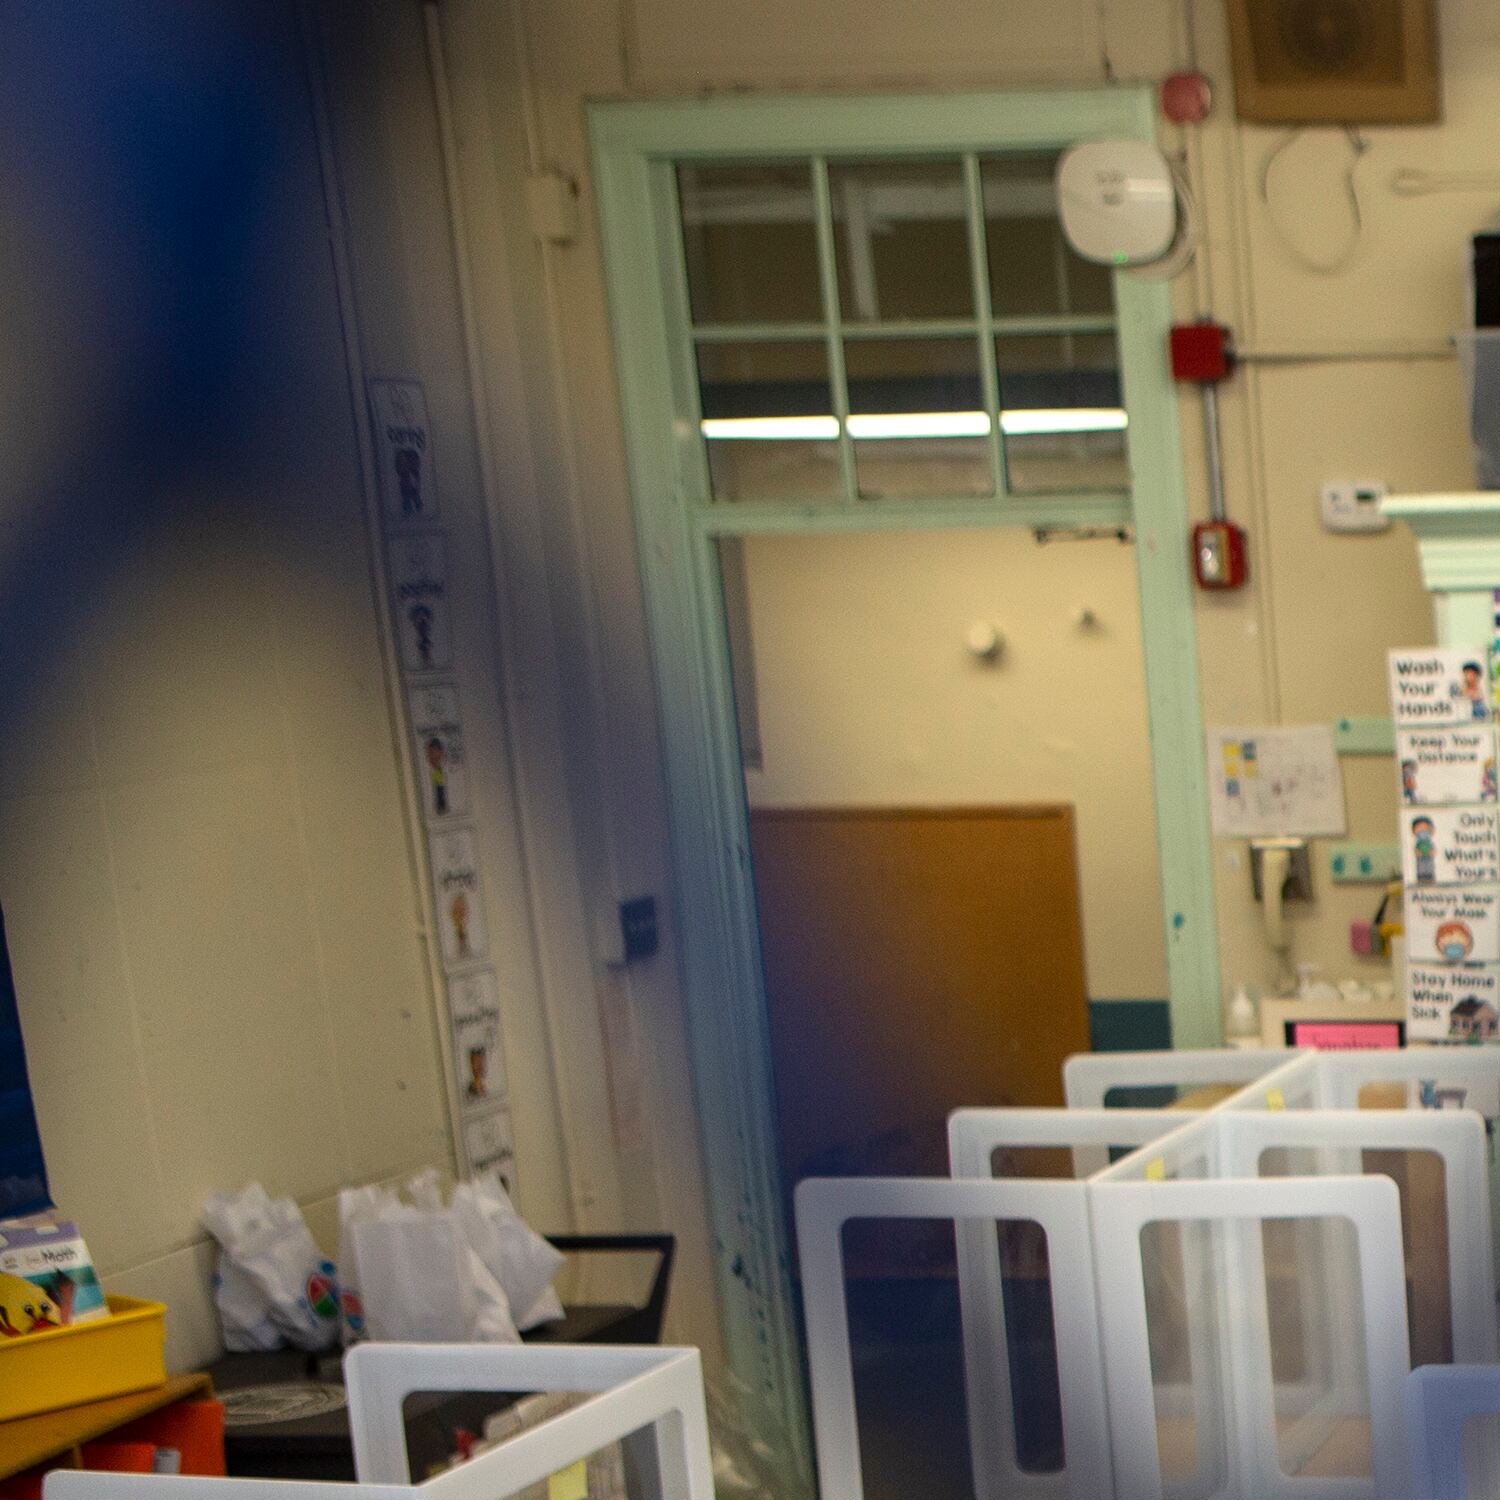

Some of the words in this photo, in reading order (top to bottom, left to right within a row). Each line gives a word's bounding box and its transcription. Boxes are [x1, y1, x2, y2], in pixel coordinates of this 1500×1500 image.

[1396, 659, 1444, 677] Wash
[1398, 681, 1436, 696] Your
[1399, 700, 1453, 717] Hands
[1410, 736, 1446, 751] Keep
[1452, 734, 1482, 747] Your
[1418, 750, 1478, 764] Distance
[1460, 814, 1496, 831] Only
[1454, 831, 1497, 845] Touch
[1444, 847, 1498, 862] What's
[1462, 892, 1494, 905] Wear
[1420, 906, 1448, 919] Your
[1453, 906, 1488, 919] Mask
[1412, 971, 1446, 988] Stay
[1451, 973, 1495, 988] Home
[1412, 990, 1454, 1003] When
[1412, 1006, 1442, 1019] Sick
